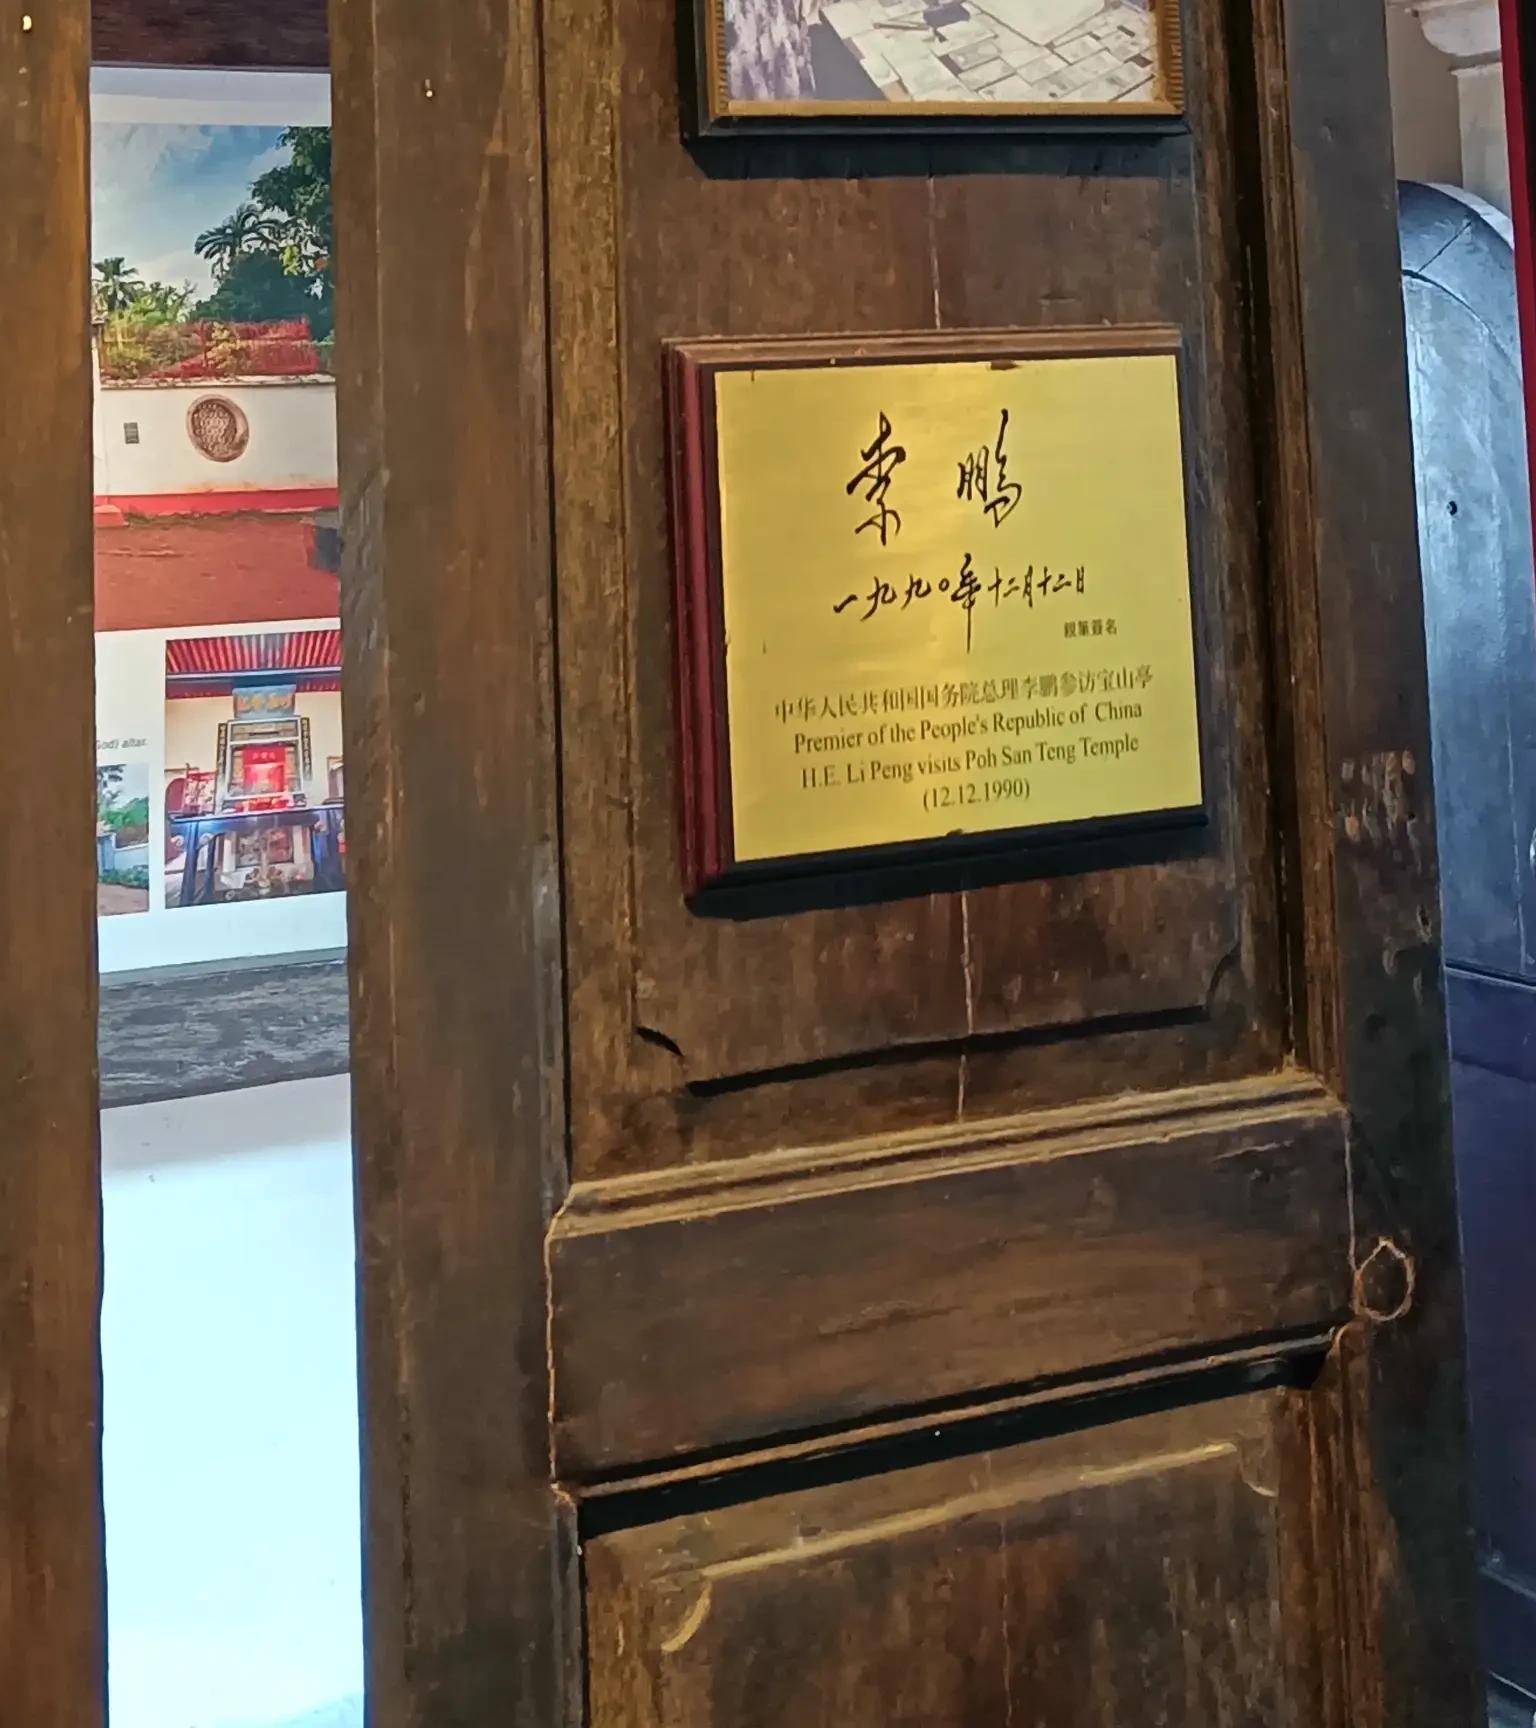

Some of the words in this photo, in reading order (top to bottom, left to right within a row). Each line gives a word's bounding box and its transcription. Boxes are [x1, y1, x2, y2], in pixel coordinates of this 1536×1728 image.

[795, 727, 863, 754] Premier
[868, 724, 887, 746] of
[889, 722, 915, 744] the
[920, 714, 988, 743] People's
[993, 705, 1064, 736] Republic
[1069, 703, 1087, 723] of
[1095, 700, 1142, 722] China
[847, 759, 865, 784] Li
[870, 759, 914, 784] Peng
[917, 752, 961, 776] visits
[966, 747, 997, 770] Poh
[1001, 745, 1032, 766] San
[1036, 741, 1076, 765] Teng
[1079, 732, 1139, 760] Temple
[923, 778, 1031, 813] (12.12.1990)
